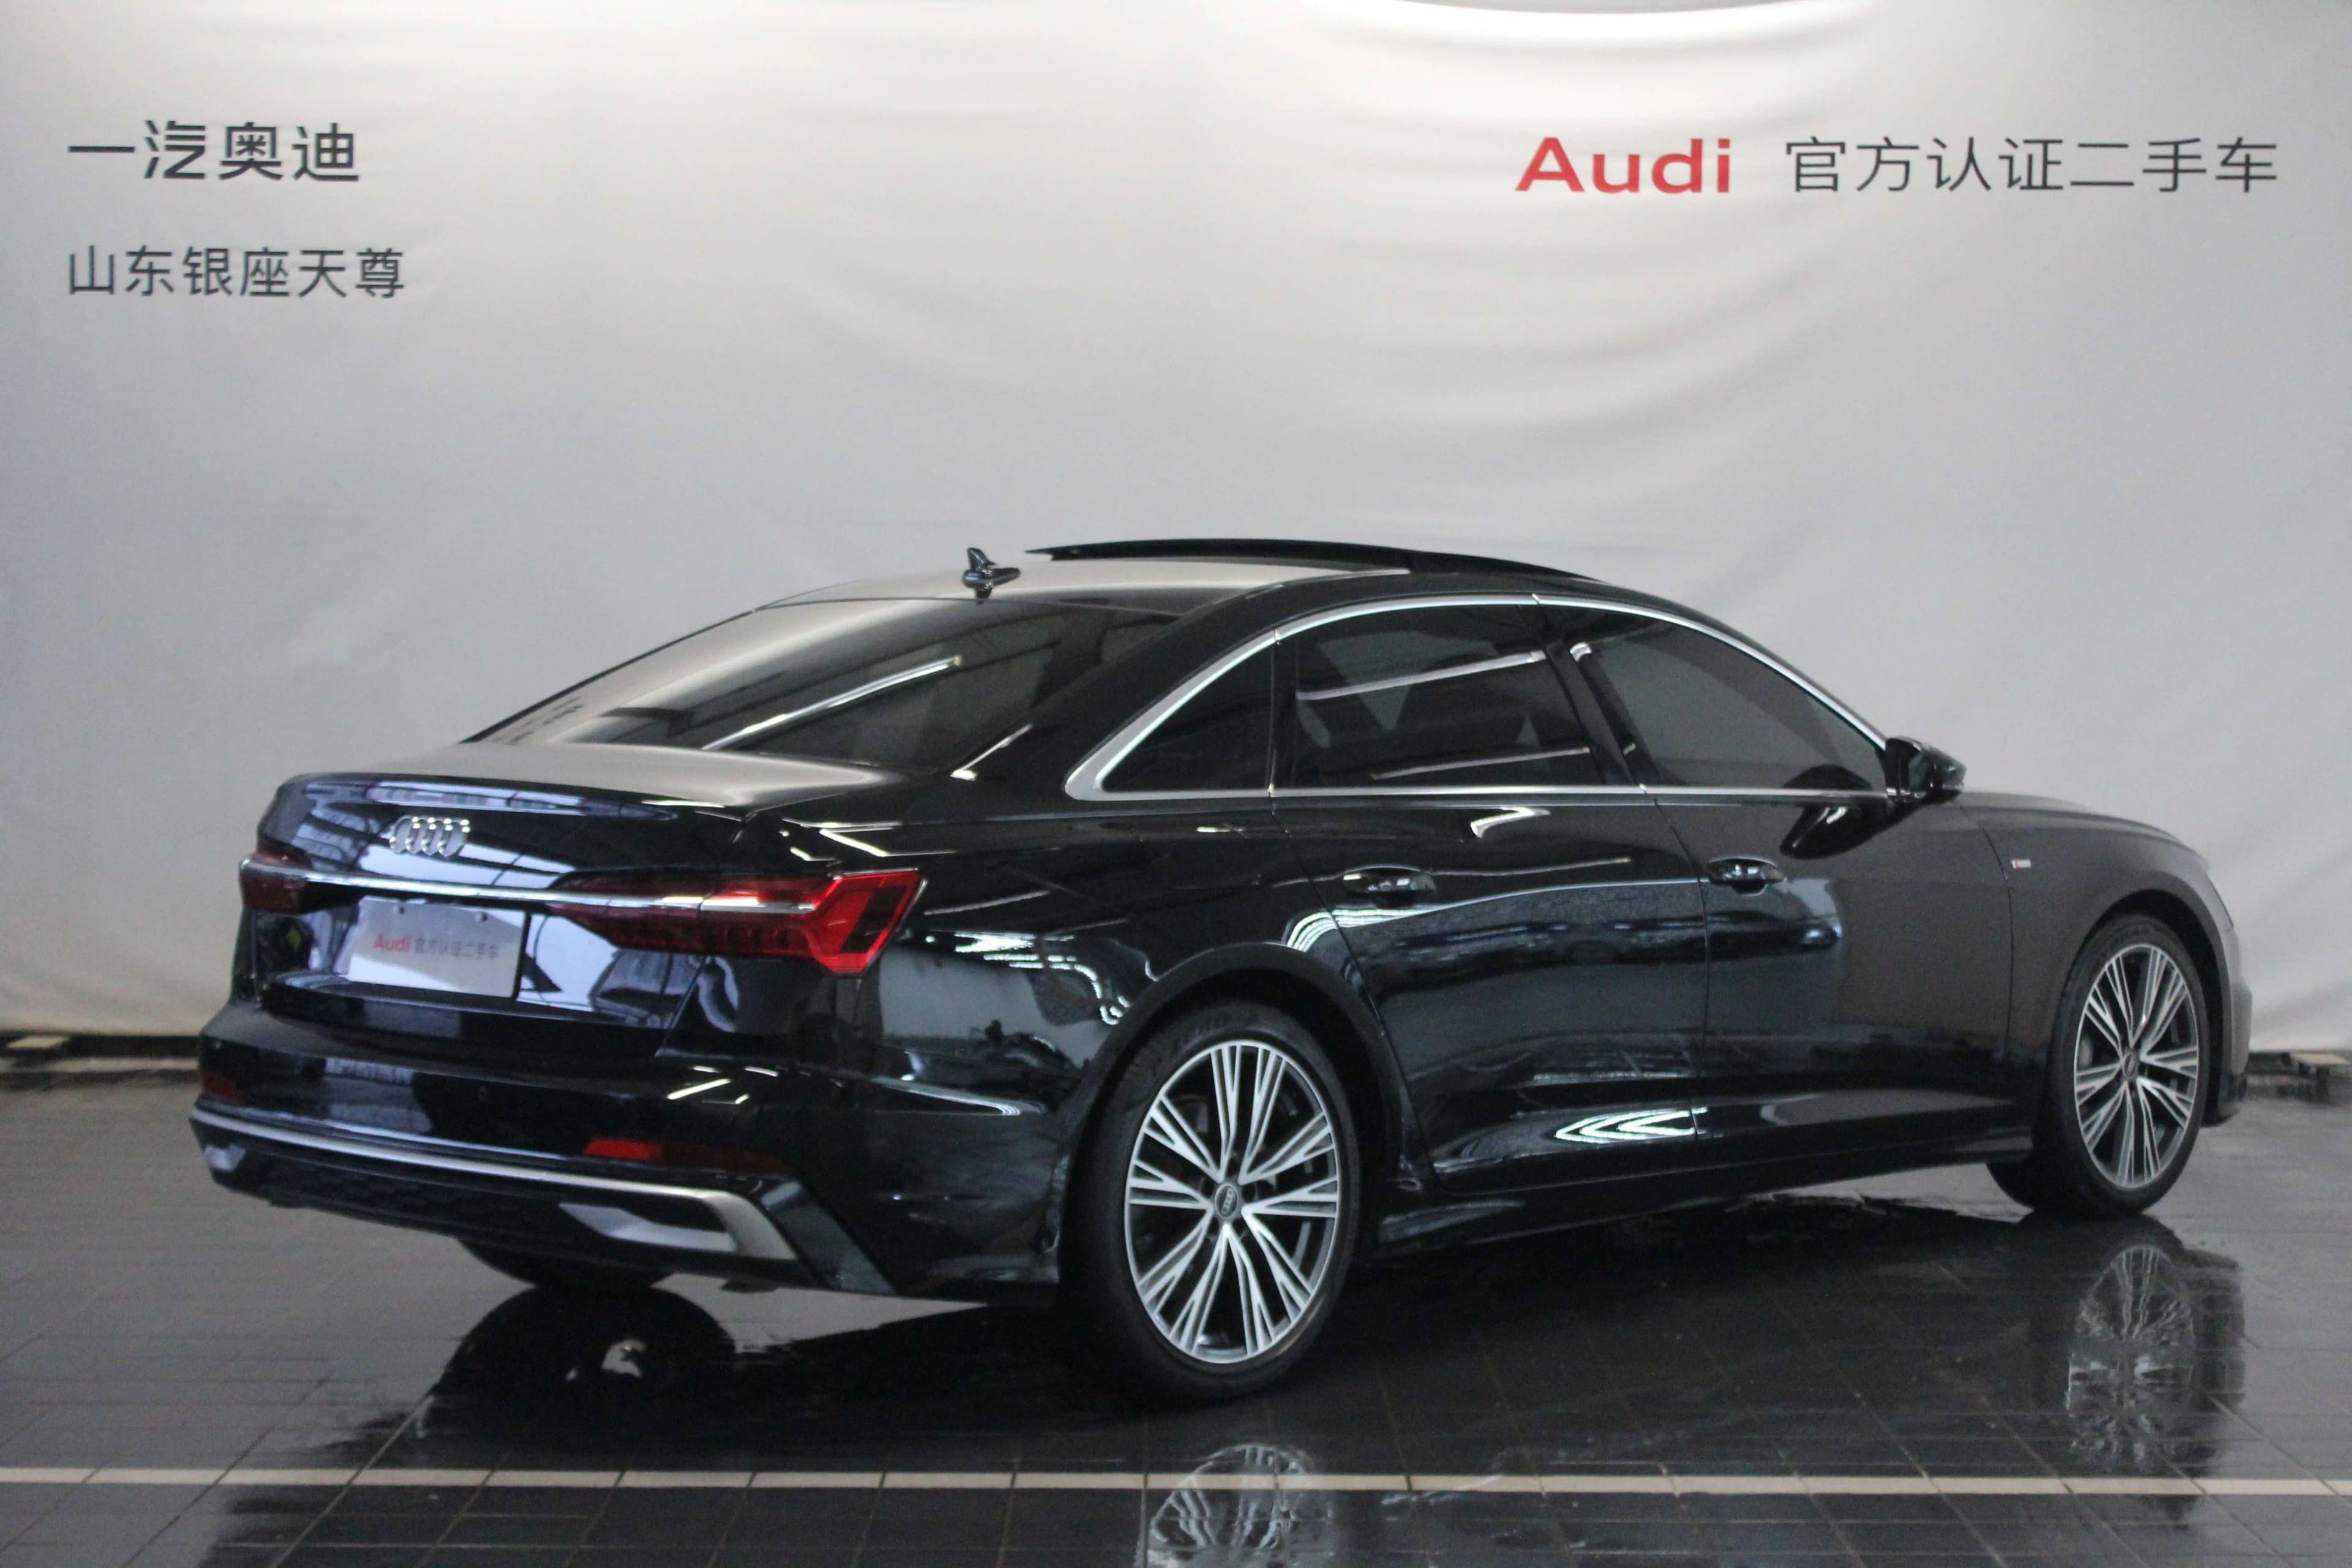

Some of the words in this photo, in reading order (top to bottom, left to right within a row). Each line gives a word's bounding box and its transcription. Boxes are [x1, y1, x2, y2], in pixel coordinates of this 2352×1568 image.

[67, 120, 360, 182] 一汽奥迪
[1516, 137, 1730, 194] Audi
[1785, 137, 2277, 194] 官方认证二手车
[69, 245, 404, 299] 山东银座天尊
[373, 934, 410, 952] Audi
